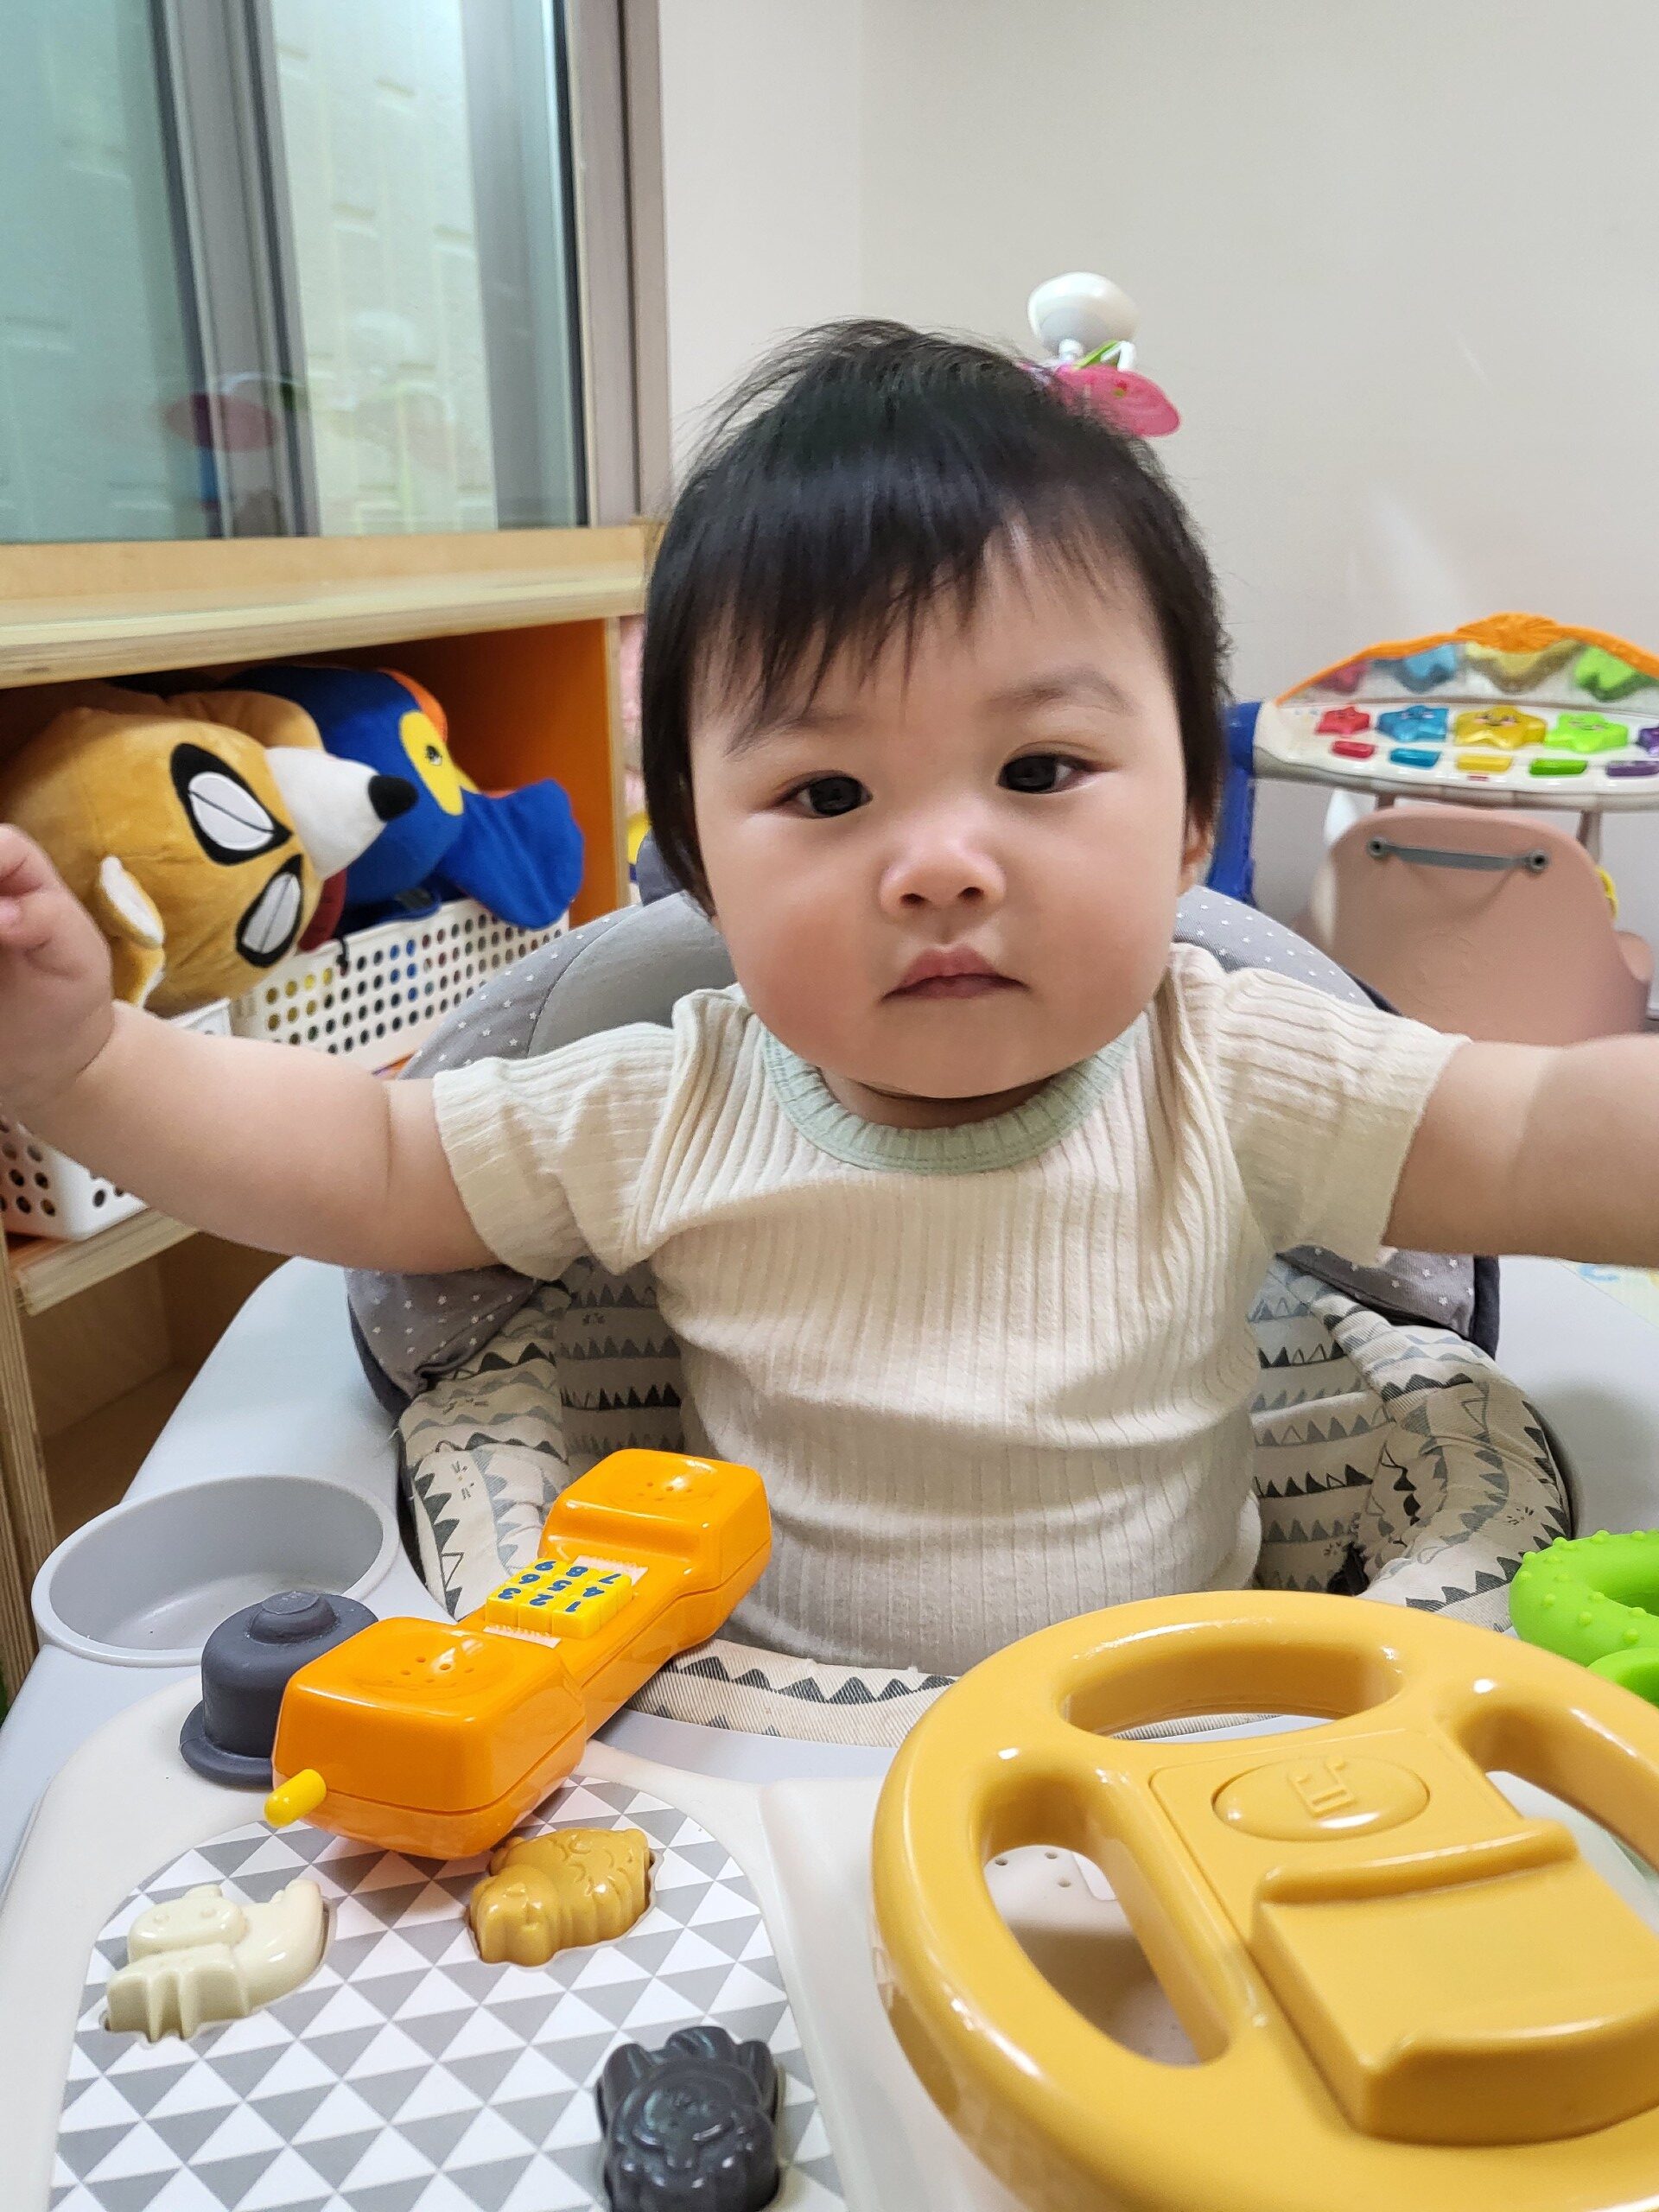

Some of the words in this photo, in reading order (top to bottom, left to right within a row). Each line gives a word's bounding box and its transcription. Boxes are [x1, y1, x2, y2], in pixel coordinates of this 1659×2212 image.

[535, 1560, 557, 1571] 9
[565, 1566, 588, 1577] 8
[518, 1573, 541, 1585] 6
[599, 1573, 622, 1585] 7
[547, 1580, 572, 1592] 5
[582, 1586, 605, 1598] 4
[498, 1587, 522, 1599] 3
[529, 1593, 554, 1606] 2
[565, 1601, 582, 1612] 1
